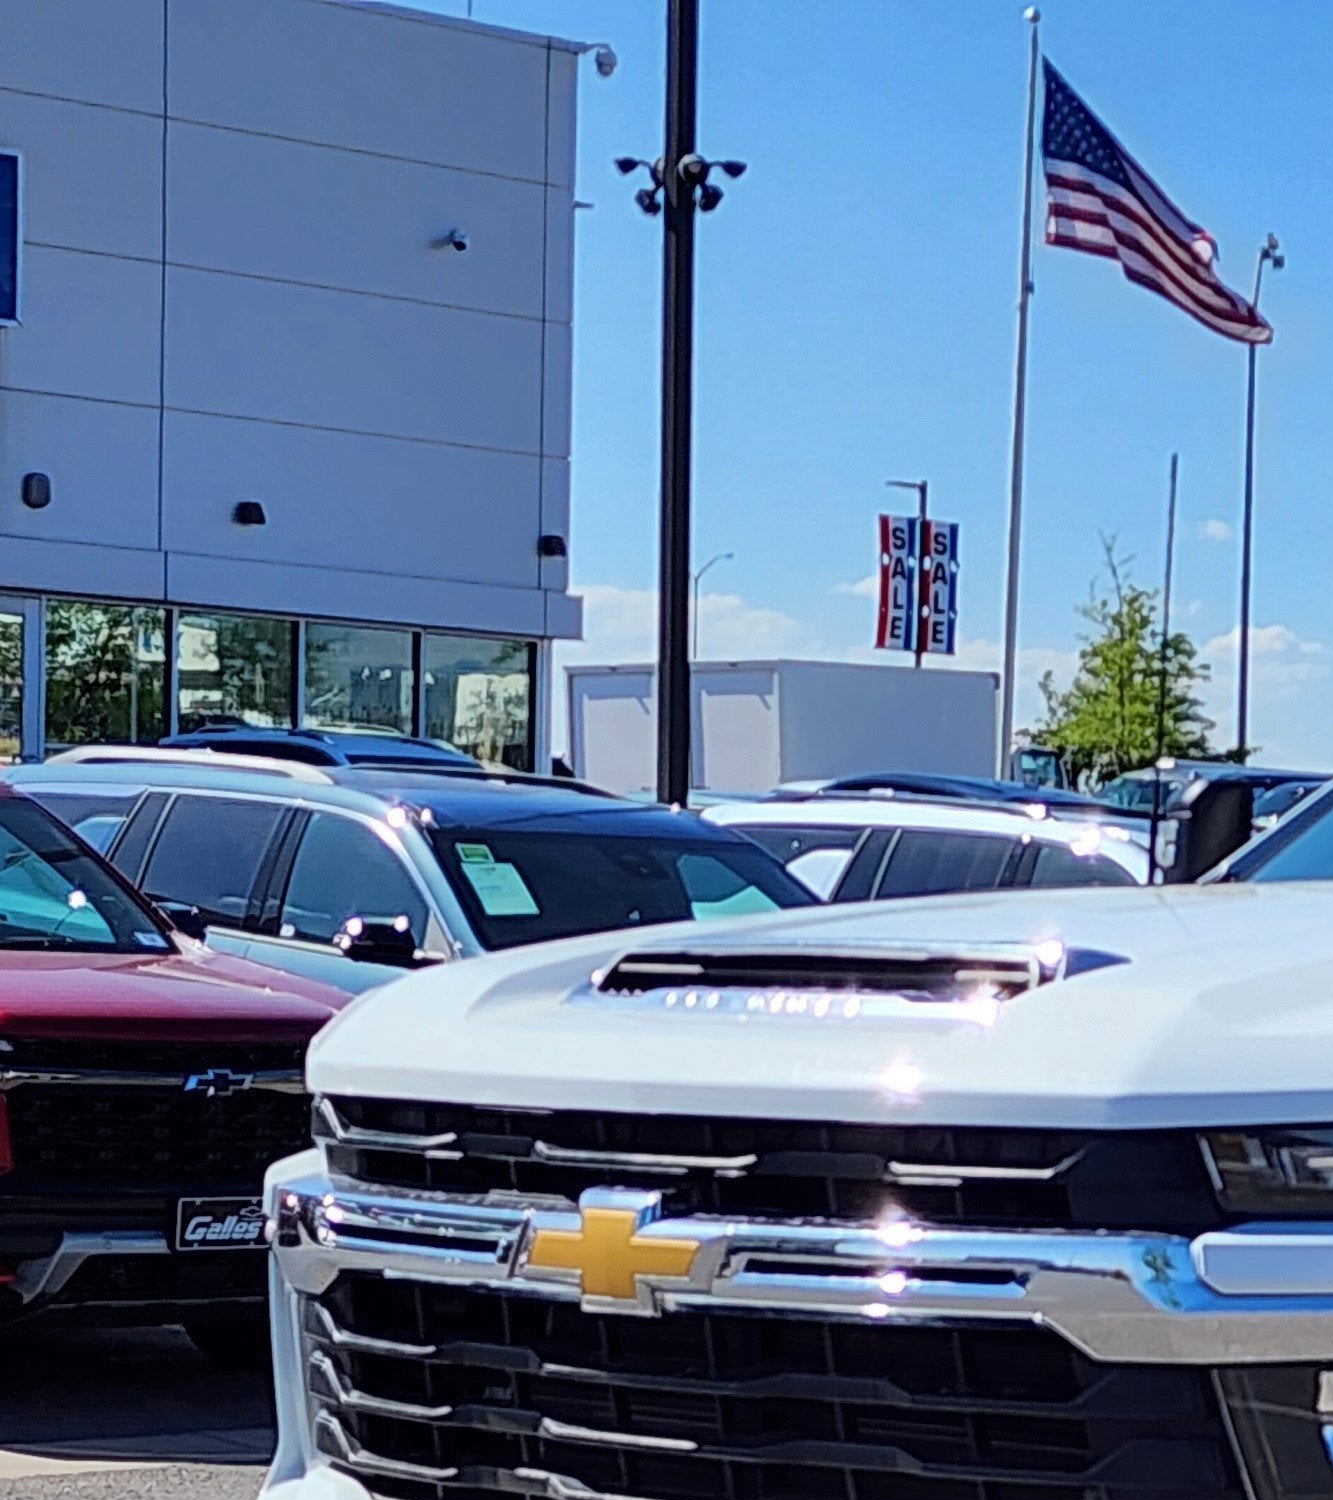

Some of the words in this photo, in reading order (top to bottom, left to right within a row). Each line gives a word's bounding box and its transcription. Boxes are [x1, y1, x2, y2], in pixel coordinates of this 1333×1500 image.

[889, 526, 907, 640] SALE
[931, 531, 948, 644] SALE
[184, 1215, 263, 1240] Galles
